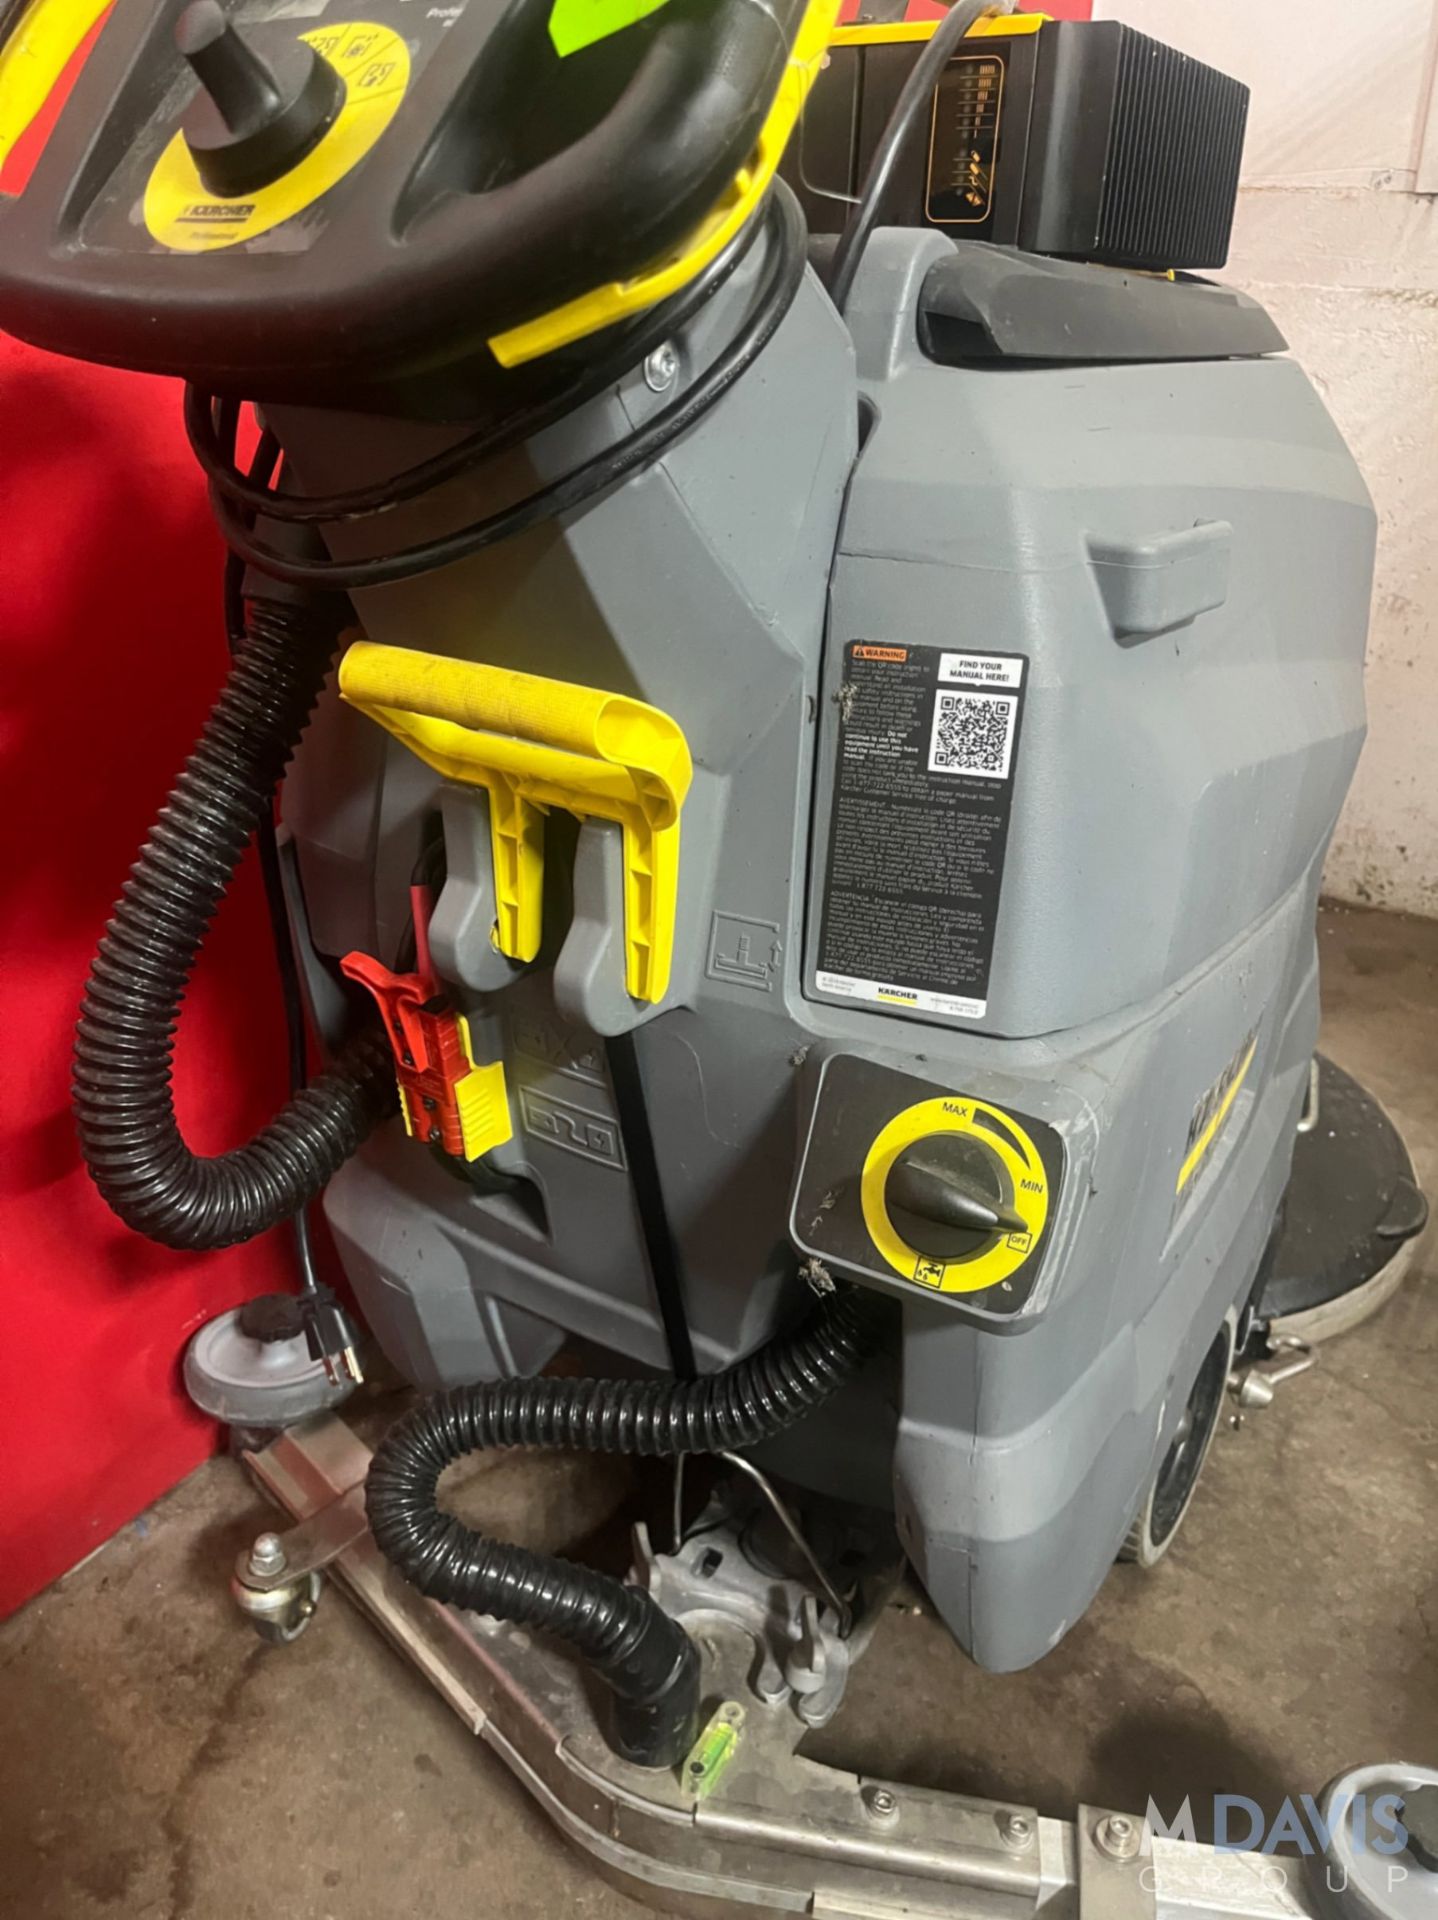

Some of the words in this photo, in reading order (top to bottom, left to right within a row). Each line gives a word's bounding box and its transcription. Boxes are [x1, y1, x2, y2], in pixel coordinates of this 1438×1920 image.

[865, 649, 905, 660] WARNING
[959, 660, 979, 669] FIND
[980, 662, 1002, 671] YOUR
[950, 669, 983, 679] MANUAL
[986, 672, 1010, 682] HERE!
[886, 729, 896, 737] Do
[868, 748, 901, 757] instruction
[890, 744, 903, 752] you
[902, 745, 919, 753] have
[942, 1101, 968, 1117] MAX
[1020, 1178, 1044, 1194] MIN
[1011, 1234, 1028, 1246] OFF
